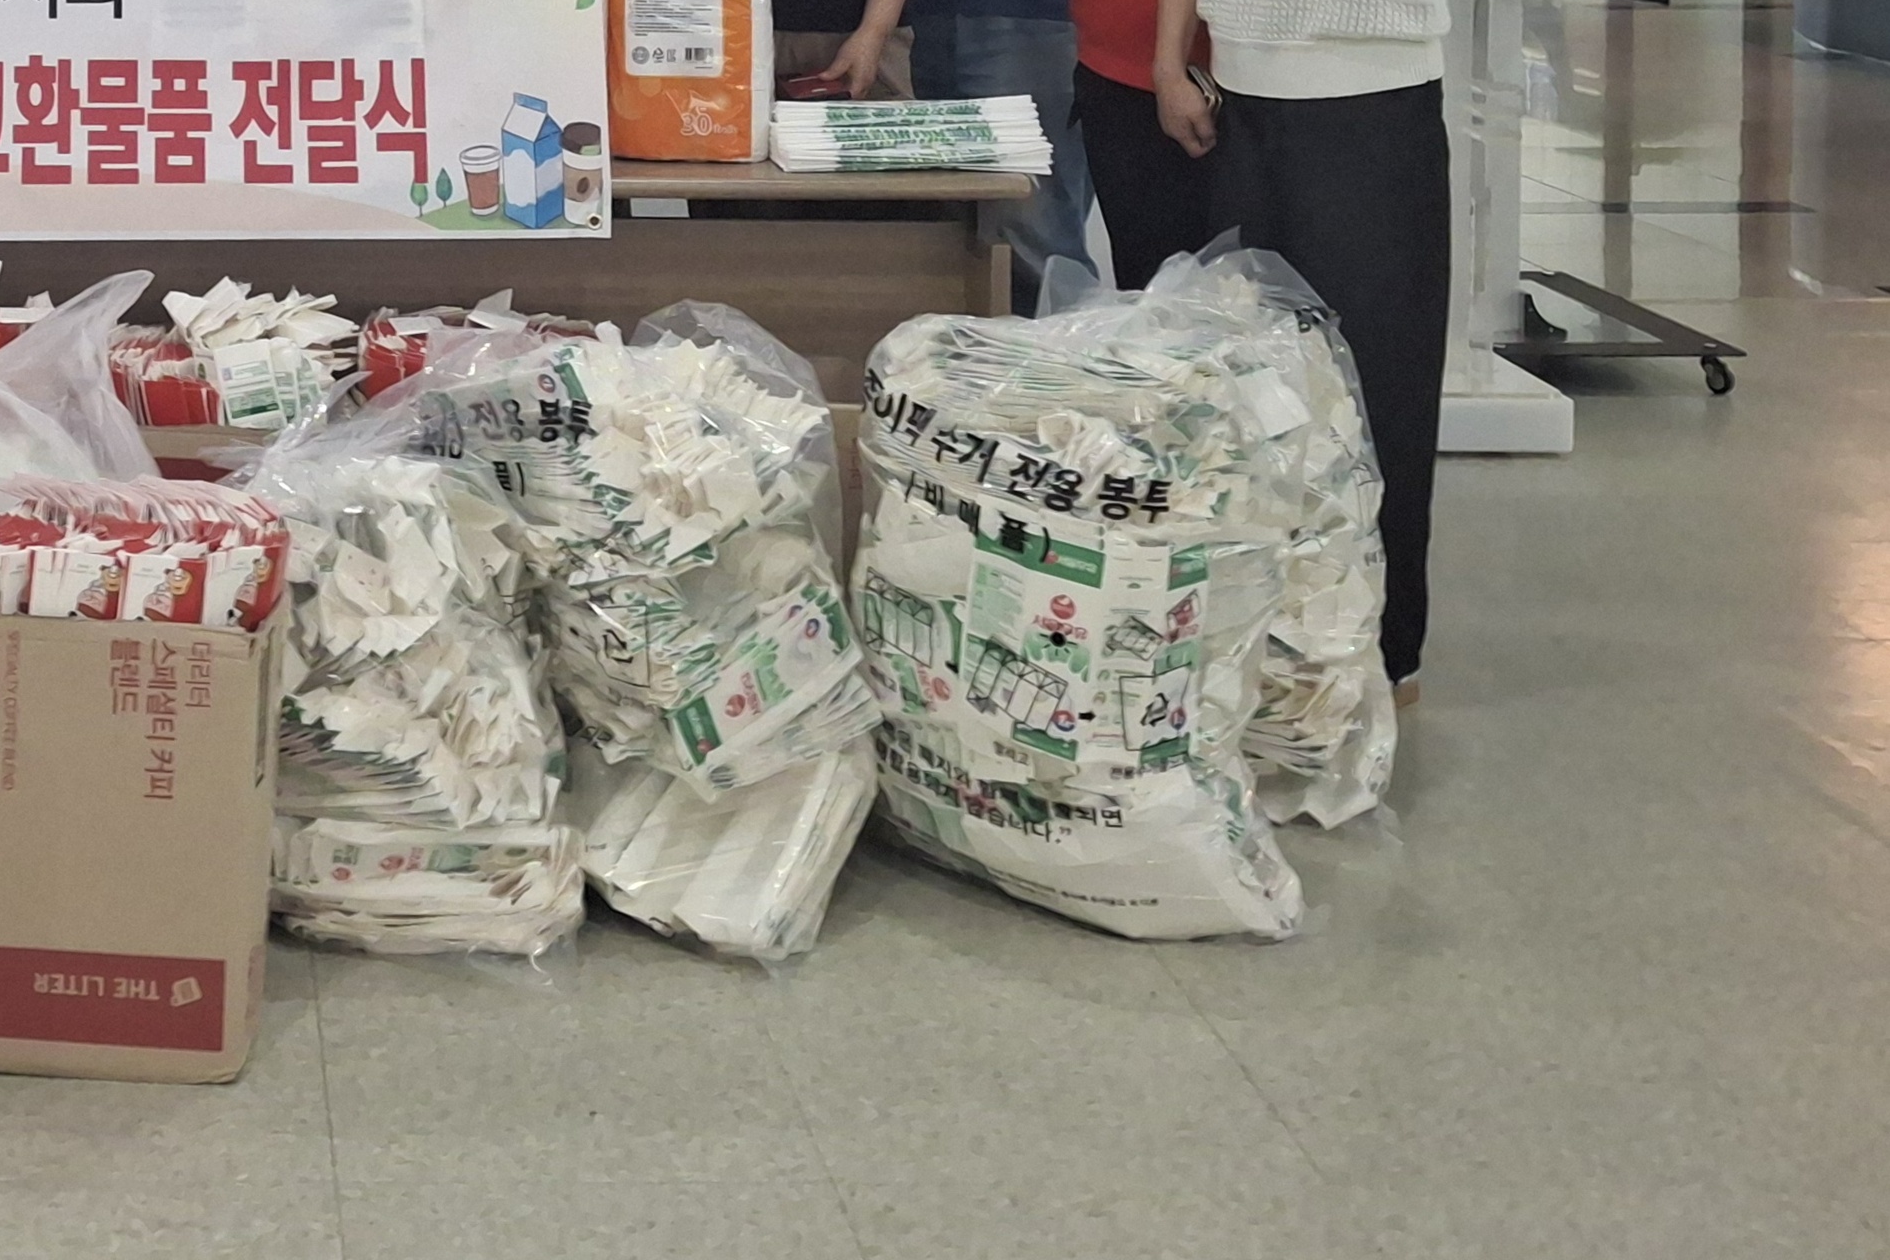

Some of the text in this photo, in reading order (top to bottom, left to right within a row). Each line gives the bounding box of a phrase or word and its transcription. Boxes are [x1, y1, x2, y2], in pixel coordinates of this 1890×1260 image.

[229, 57, 429, 185] 전달식
[1096, 472, 1174, 523] 봉투
[185, 641, 212, 709] 더리터
[143, 748, 177, 801] 커피
[33, 972, 161, 1001] THE LITER
